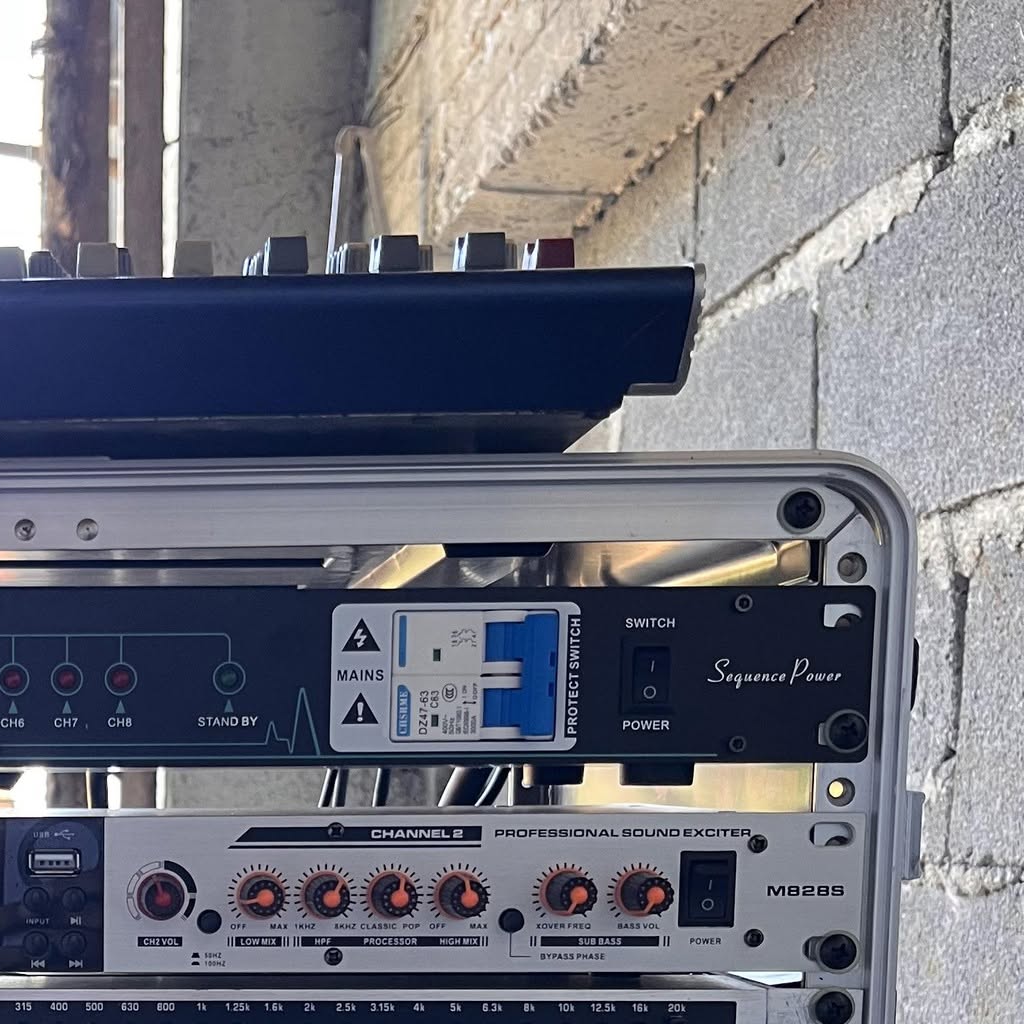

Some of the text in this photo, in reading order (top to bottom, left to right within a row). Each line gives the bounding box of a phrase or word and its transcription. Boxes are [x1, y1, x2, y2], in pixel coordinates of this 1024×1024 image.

[625, 617, 676, 629] SWITCH
[336, 669, 385, 682] MAINS
[567, 617, 581, 735] PROTECT SWITCH
[707, 657, 842, 689] Sequence Power
[429, 690, 440, 709] C63
[418, 690, 430, 735] DZ47-63
[0, 717, 25, 730] CH6
[53, 717, 79, 729] CH7
[107, 717, 133, 729] CH8
[197, 716, 259, 728] STAND BY
[622, 720, 670, 731] POWER
[370, 829, 452, 839] CHANNEL
[494, 829, 752, 839] PROFESSIONAL SOUND EXCITER
[766, 885, 845, 898] M828S
[25, 918, 50, 926] INPUT
[535, 922, 592, 931] XOVER FREQ
[617, 922, 661, 930] BASS VOL
[143, 937, 179, 946] CH2 VOL
[240, 937, 277, 946] LOW MIX
[314, 937, 332, 946] HPF
[363, 937, 418, 946] PROCESSOR
[439, 937, 479, 946] HIGH MIX
[577, 936, 623, 946] SUB BASS
[689, 937, 722, 946] POWER
[539, 952, 606, 961] BYPASS PHASE
[14, 1001, 32, 1013] 315
[49, 1001, 69, 1013] 400
[85, 1001, 104, 1013] 500
[120, 1001, 140, 1013] 630
[156, 1001, 176, 1013] 800
[196, 1001, 208, 1013] 1k
[225, 1001, 251, 1013] 1.25k
[263, 1001, 284, 1013] 1.6k
[303, 1001, 316, 1013] 2k
[335, 1002, 357, 1014] 2.5k
[369, 1002, 395, 1014] 3.15k
[412, 1002, 426, 1014] 4k
[449, 1002, 462, 1014] 5k
[481, 1002, 503, 1014] 6.3k
[522, 1002, 536, 1014] 8k
[557, 1002, 576, 1014] 10k
[589, 1002, 616, 1014] 12.5k
[631, 1002, 649, 1014] 16k
[667, 1002, 686, 1014] 20k
